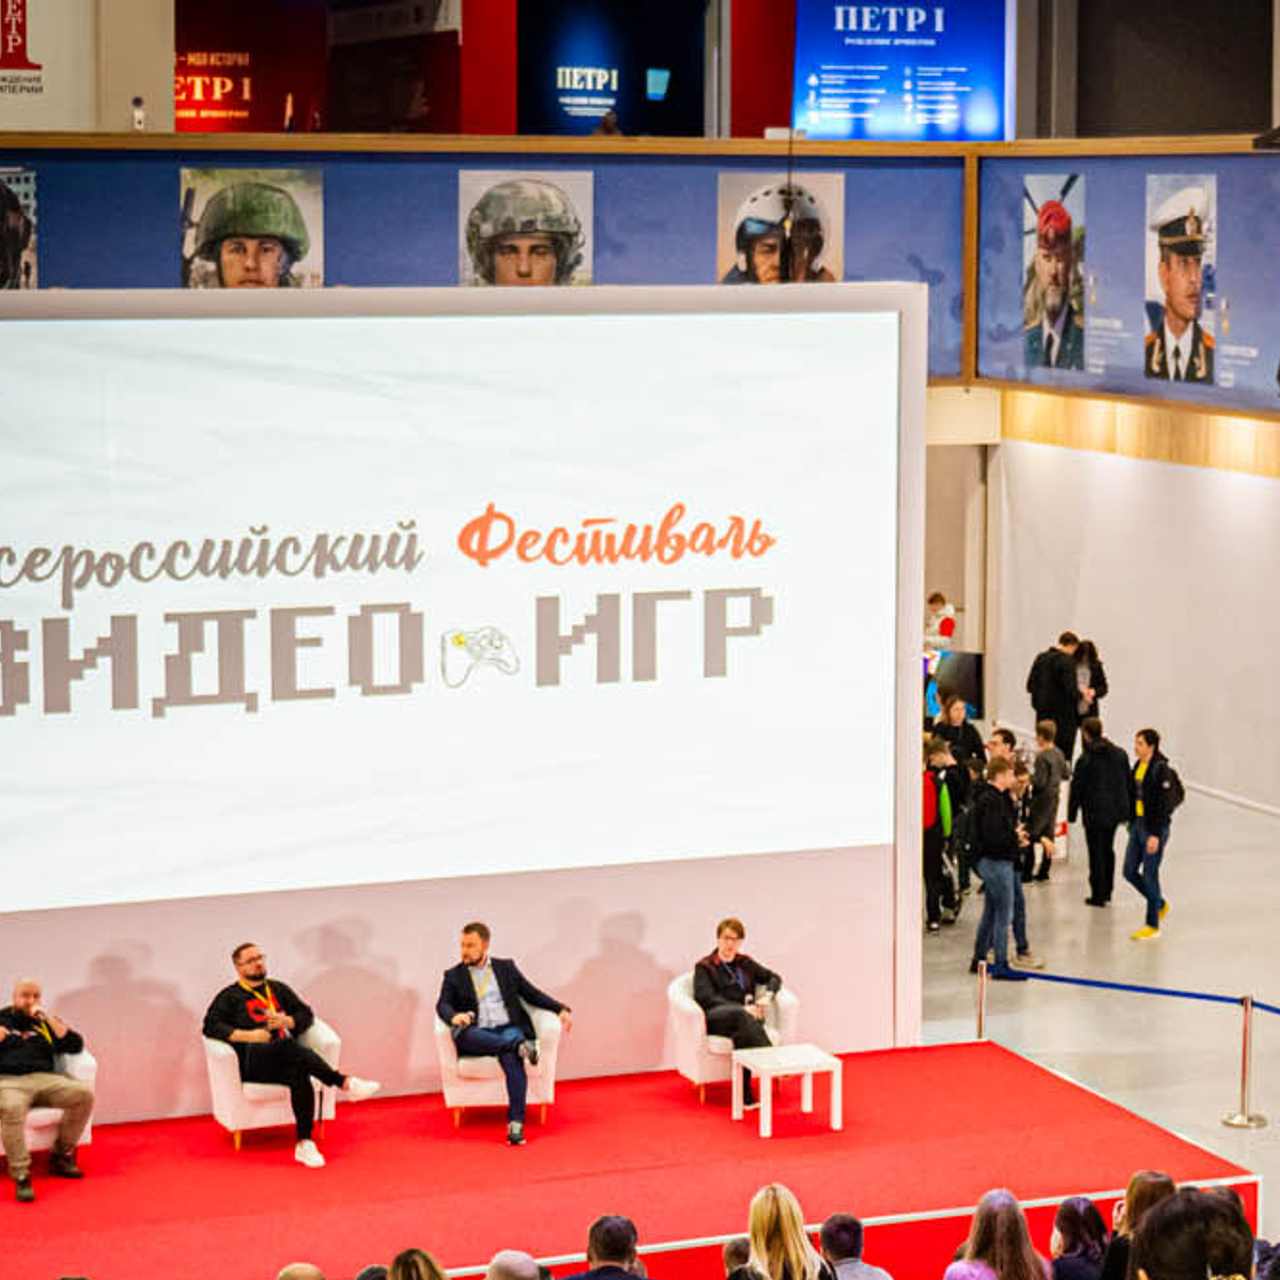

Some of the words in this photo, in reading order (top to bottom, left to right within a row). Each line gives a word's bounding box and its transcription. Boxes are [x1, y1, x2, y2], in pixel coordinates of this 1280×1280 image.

[834, 6, 927, 32] ПЕТР
[556, 67, 609, 90] ПЕТР
[457, 501, 777, 568] Фестиваль
[535, 586, 774, 687] ИГР
